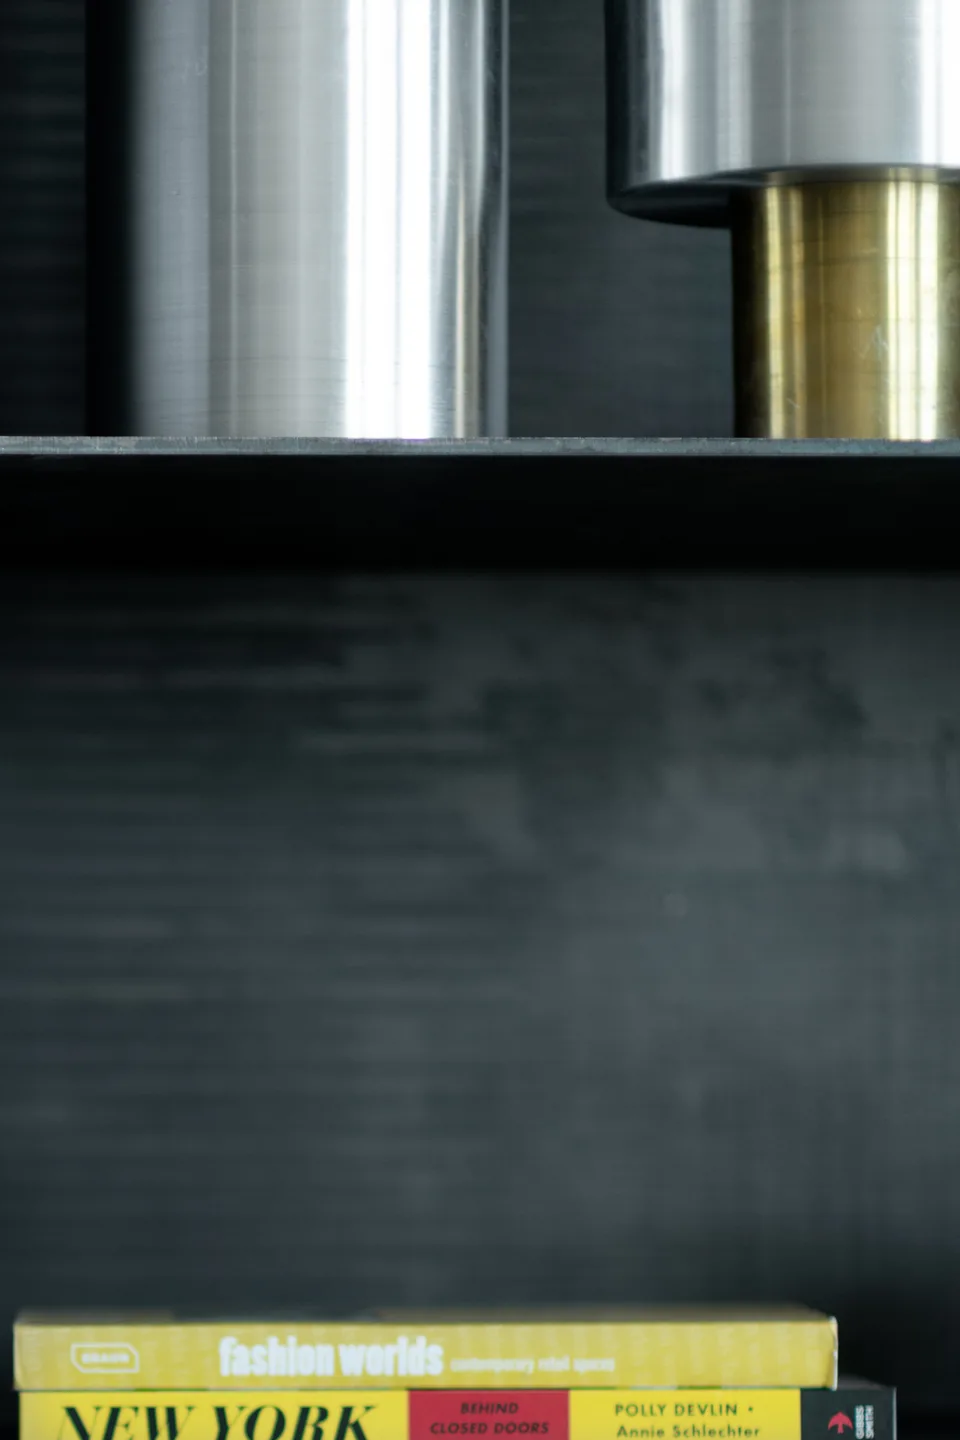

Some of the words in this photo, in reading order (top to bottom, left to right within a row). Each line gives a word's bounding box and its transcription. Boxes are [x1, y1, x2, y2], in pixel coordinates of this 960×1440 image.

[219, 1336, 335, 1376] fashion
[338, 1336, 444, 1376] worlds
[460, 1402, 519, 1414] BEHIND
[615, 1404, 666, 1416] POLLY
[674, 1404, 737, 1416] DEVLIN
[430, 1422, 488, 1434] CLOSED
[493, 1422, 549, 1434] DOORS
[855, 1405, 864, 1439] GIBBS
[865, 1405, 874, 1439] SMITH
[617, 1424, 665, 1438] Annie
[672, 1423, 761, 1438] Schlechter
